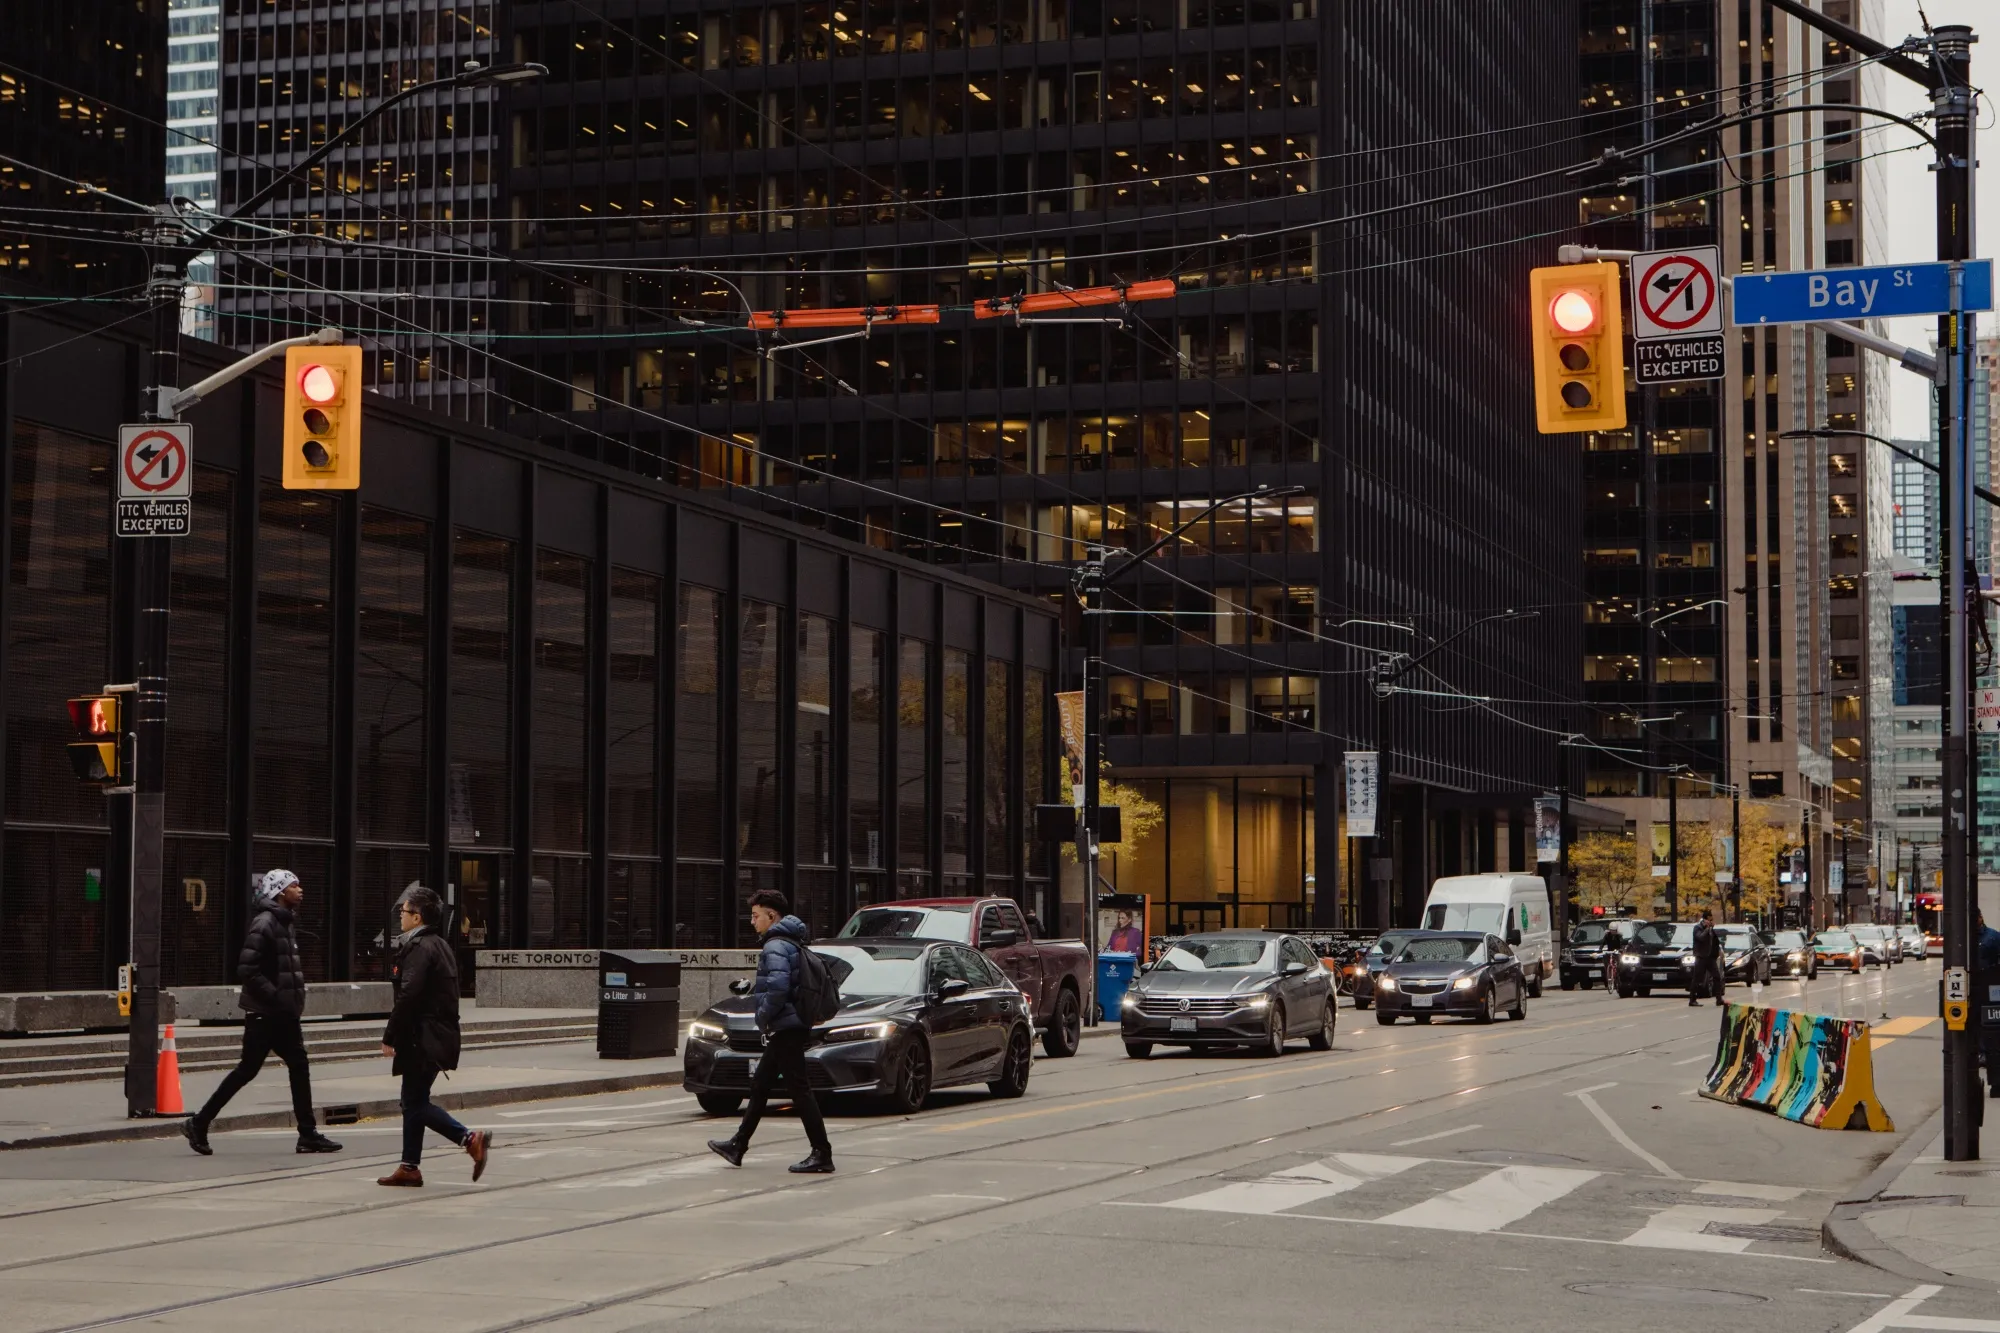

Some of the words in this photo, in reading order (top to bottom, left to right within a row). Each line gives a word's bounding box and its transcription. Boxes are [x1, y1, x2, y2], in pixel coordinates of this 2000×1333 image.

[1808, 275, 1879, 313] Bay
[1893, 269, 1914, 287] St
[1638, 345, 1662, 360] TTC
[1667, 340, 1723, 358] VEHICLES
[1642, 359, 1719, 377] EXCEPTED
[120, 504, 139, 517] TTC
[143, 504, 188, 516] VEHICLES
[122, 518, 185, 531] EXCEPTED
[1984, 692, 1994, 704] NO
[1977, 706, 2000, 718] STANDIN
[1060, 699, 1075, 745] BEAUTY
[1535, 801, 1544, 832] CONNECT
[492, 953, 519, 964] THE
[680, 953, 720, 965] BANK
[744, 954, 758, 965] THE
[612, 990, 629, 1000] Litter
